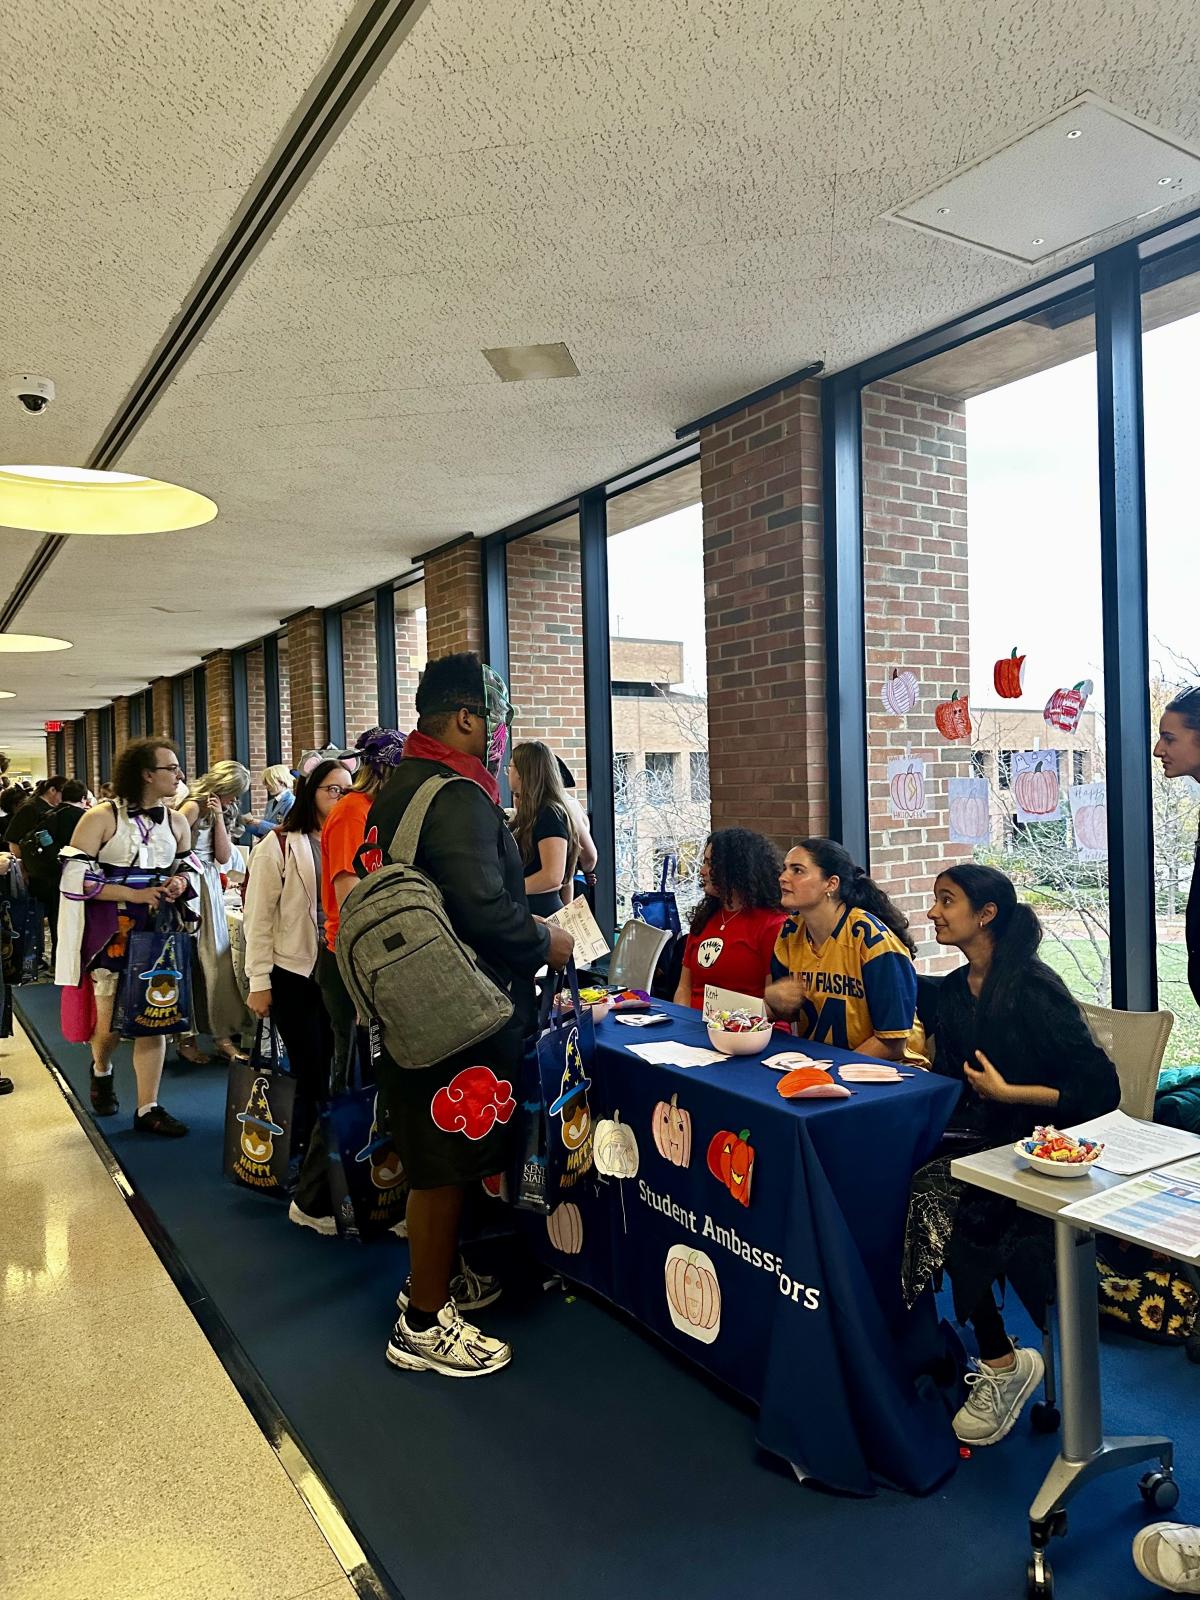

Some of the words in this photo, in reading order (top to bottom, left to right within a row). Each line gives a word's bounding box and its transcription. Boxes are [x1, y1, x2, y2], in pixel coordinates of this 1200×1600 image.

[48, 722, 61, 731] EXIT
[701, 941, 721, 953] THING
[704, 952, 710, 963] 4
[705, 986, 718, 1000] Kent
[144, 1006, 178, 1018] HAPPY
[566, 1133, 593, 1171] HAPPY
[240, 1154, 271, 1177] HAPPY
[523, 1164, 546, 1178] KENT
[522, 1173, 546, 1185] STATE
[638, 1179, 697, 1233] Student
[702, 1215, 820, 1310] Ambassaors
